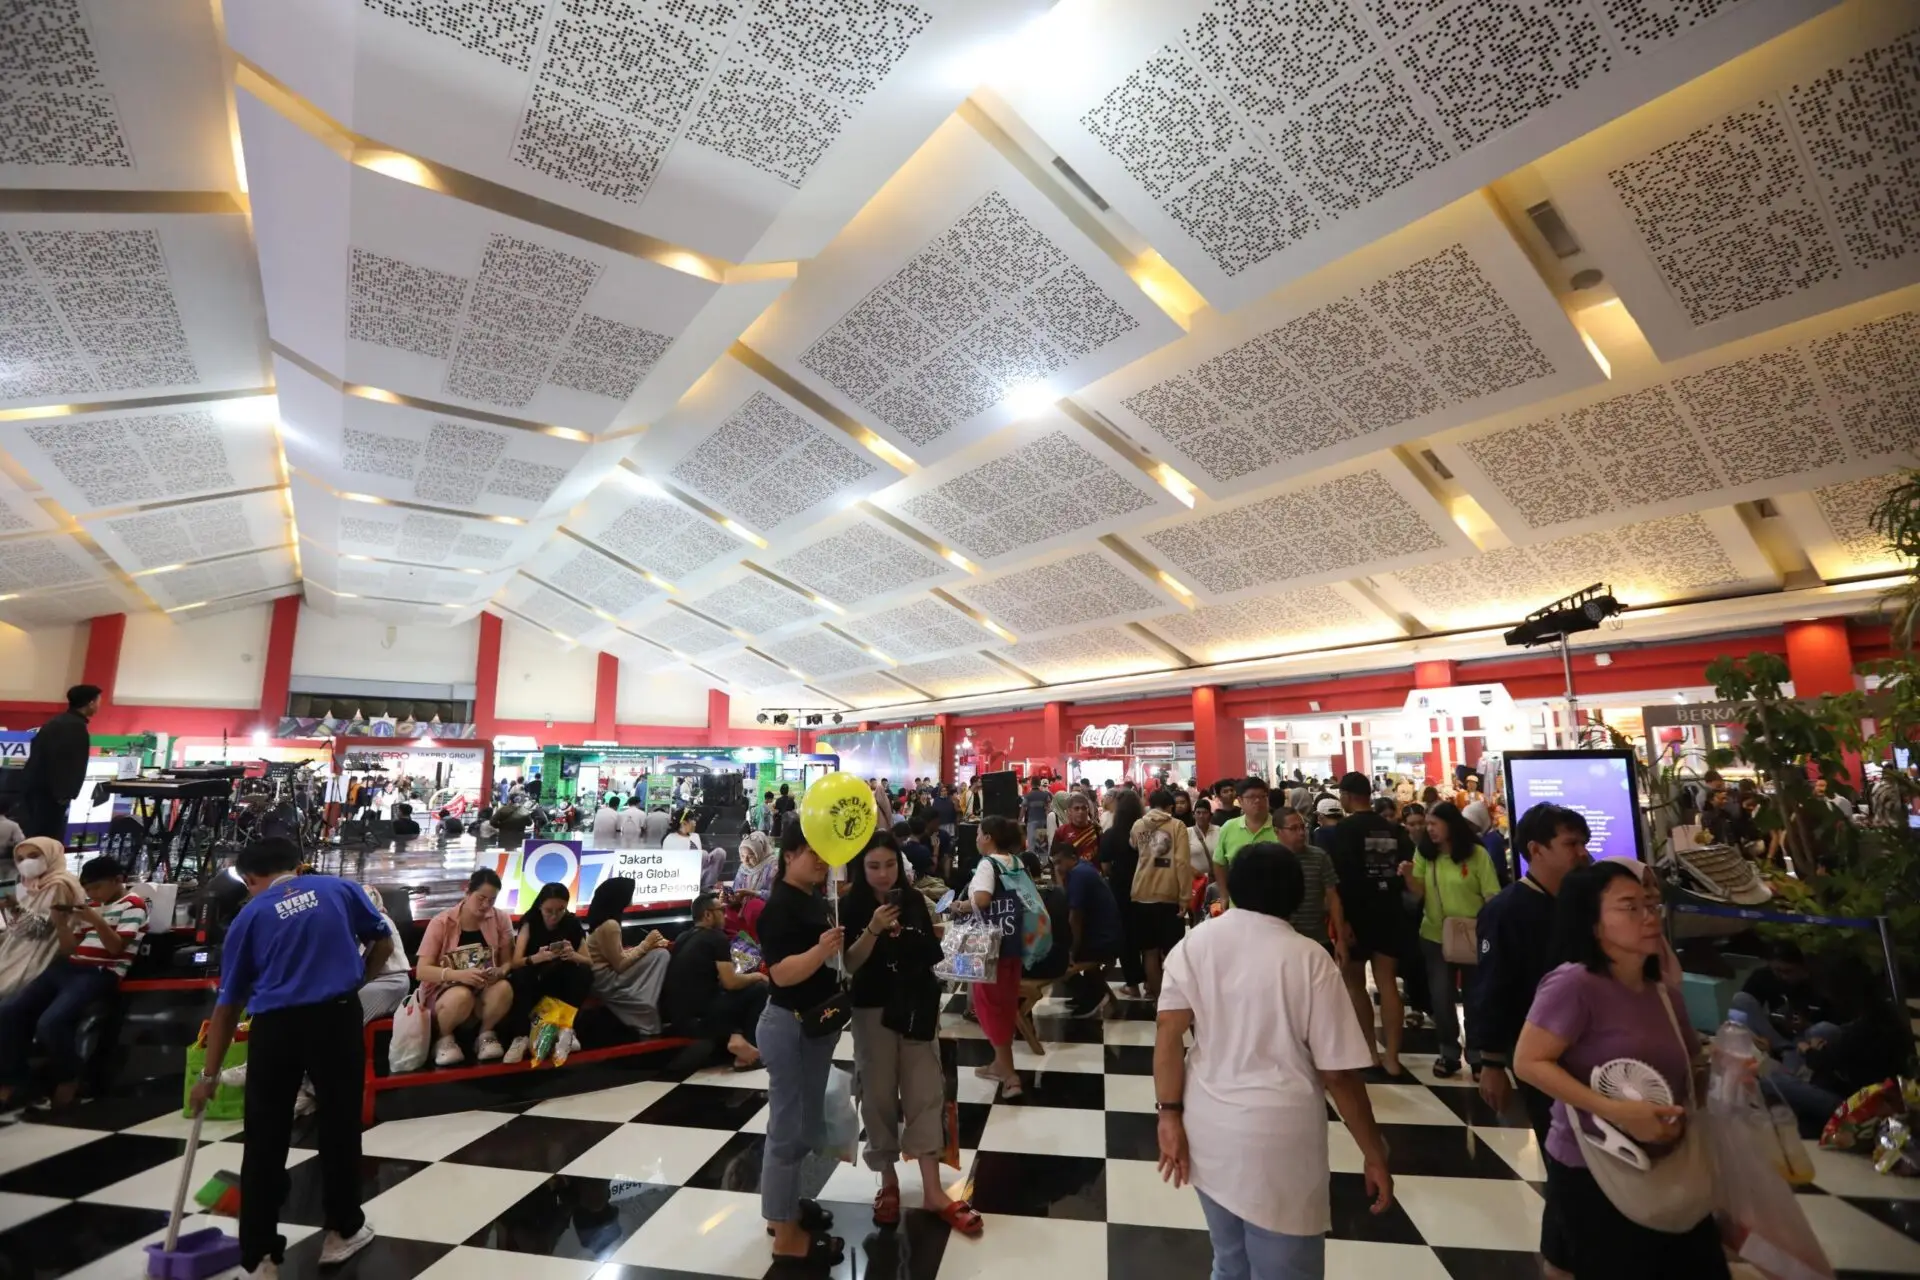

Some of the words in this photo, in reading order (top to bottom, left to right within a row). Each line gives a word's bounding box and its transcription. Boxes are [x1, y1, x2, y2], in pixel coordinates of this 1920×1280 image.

[449, 752, 476, 760] GROUP
[619, 853, 663, 865] Jakarta
[618, 869, 643, 881] Kota
[646, 867, 680, 880] Global
[274, 890, 316, 914] EVENT
[280, 899, 319, 920] CREW
